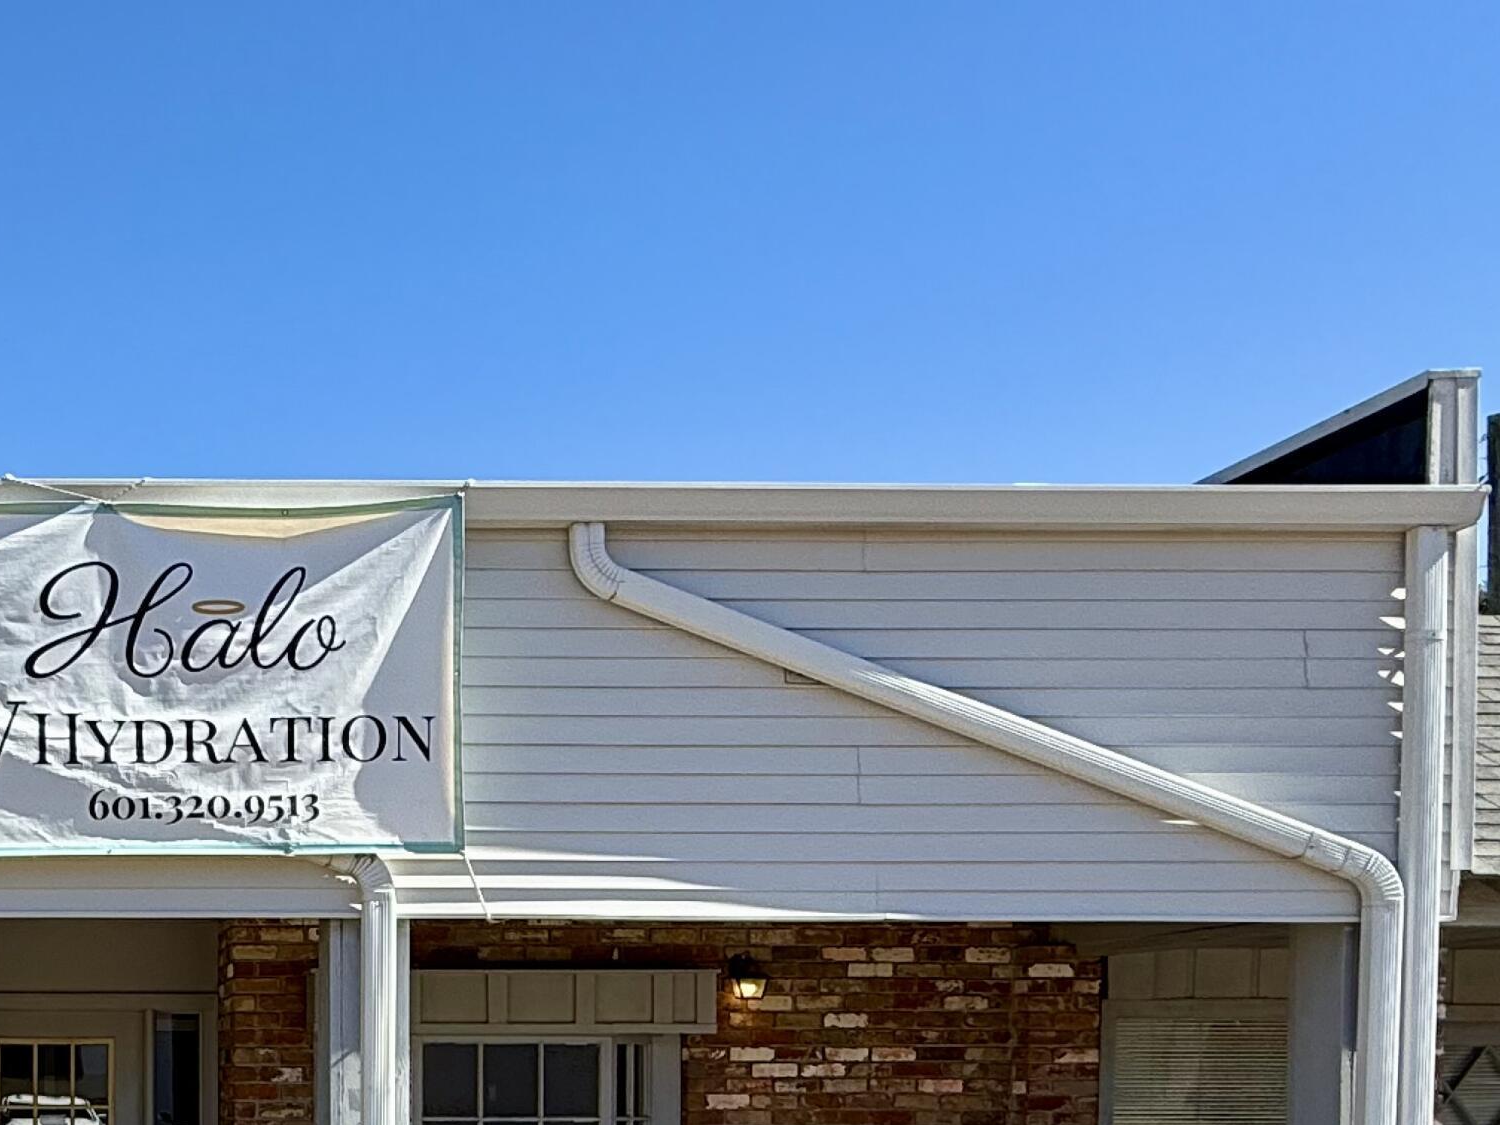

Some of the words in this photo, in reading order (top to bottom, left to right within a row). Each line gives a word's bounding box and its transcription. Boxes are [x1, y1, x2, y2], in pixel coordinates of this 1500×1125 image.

[24, 561, 346, 680] Halo
[32, 711, 435, 767] HYDRATION
[88, 789, 321, 826] 601.320.9513
